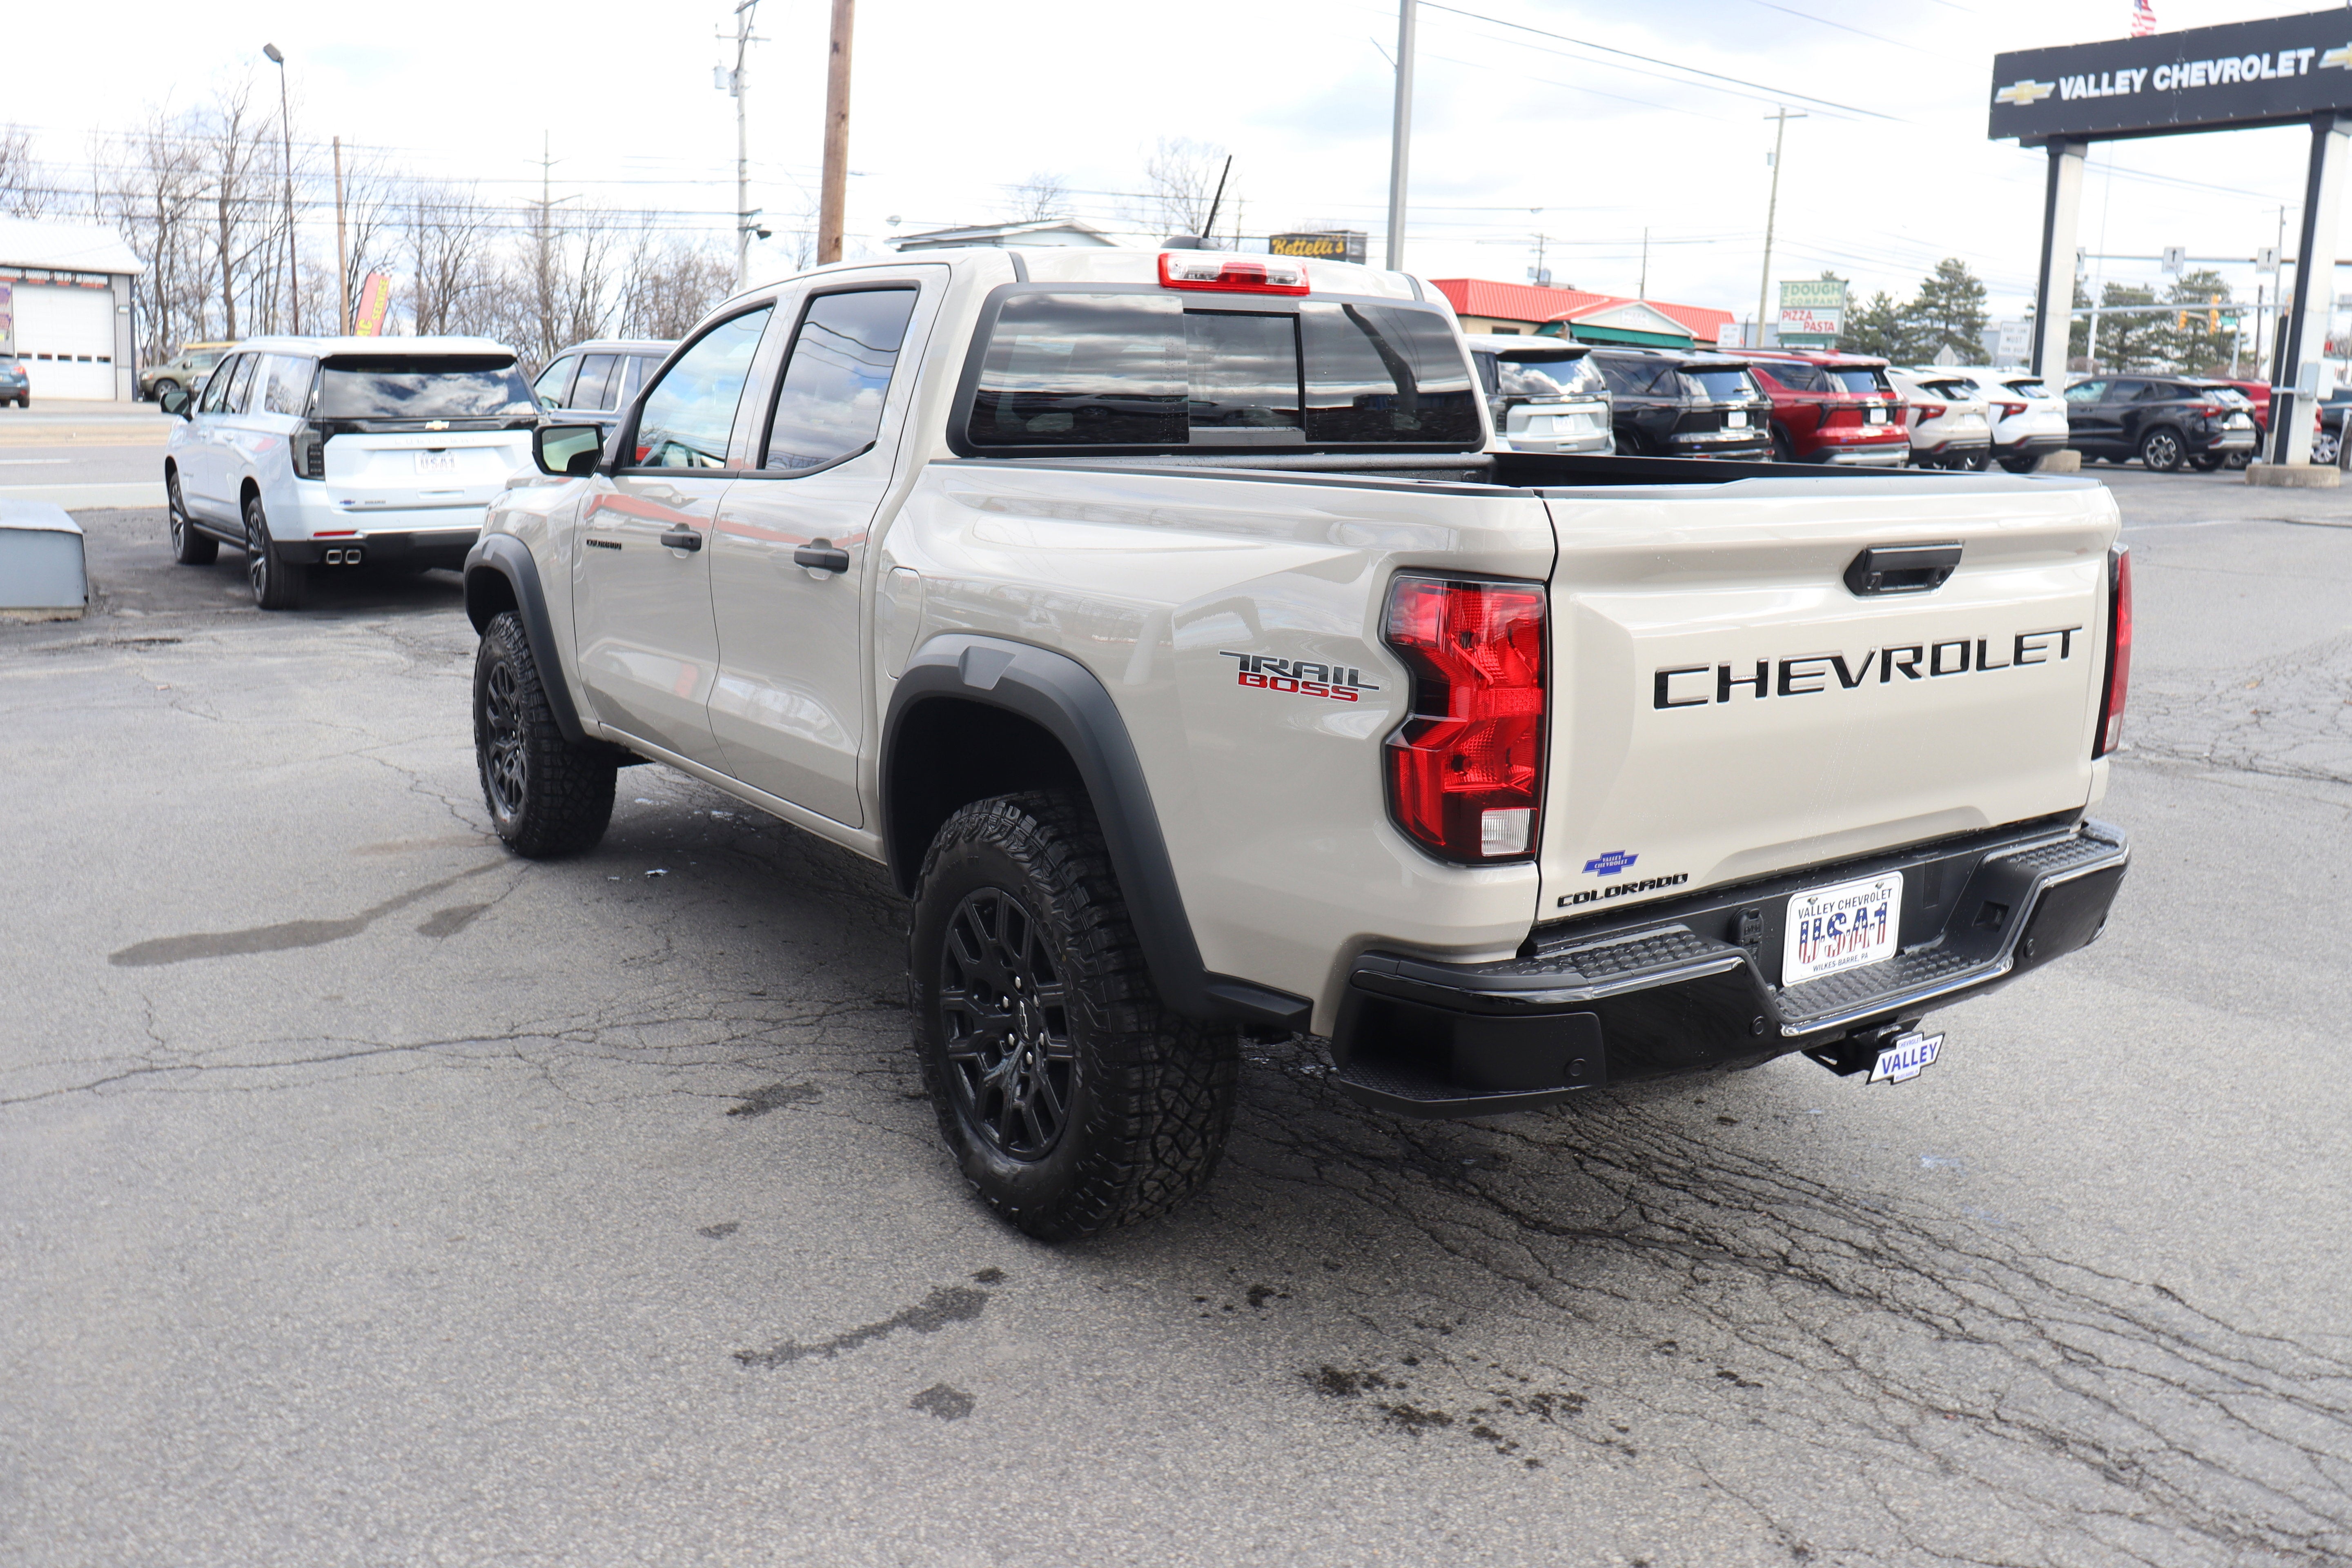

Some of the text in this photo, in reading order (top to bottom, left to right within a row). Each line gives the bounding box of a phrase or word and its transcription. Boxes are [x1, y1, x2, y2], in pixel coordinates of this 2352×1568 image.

[2059, 47, 2315, 100] VALLEY CHEVROLET
[1272, 235, 1345, 256] Bettelli's
[371, 278, 390, 320] SERVICE
[1791, 284, 1840, 295] DOUGH
[1782, 310, 1813, 321] PIZZA
[1804, 321, 1835, 332] PASTA
[1219, 649, 1380, 691] TRAIL
[1654, 624, 2083, 710] CHEVROLET
[1237, 671, 1359, 703] BOSS
[1594, 858, 1628, 869] CHEVROLET
[1602, 854, 1622, 863] VALLEY
[1557, 871, 1689, 907] COLORADO
[1798, 888, 1893, 919] VALLEY CHEVROLET
[1861, 952, 1868, 960] PA
[1898, 1036, 1921, 1048] CHEVROLET
[1882, 1042, 1938, 1074] VALLEY
